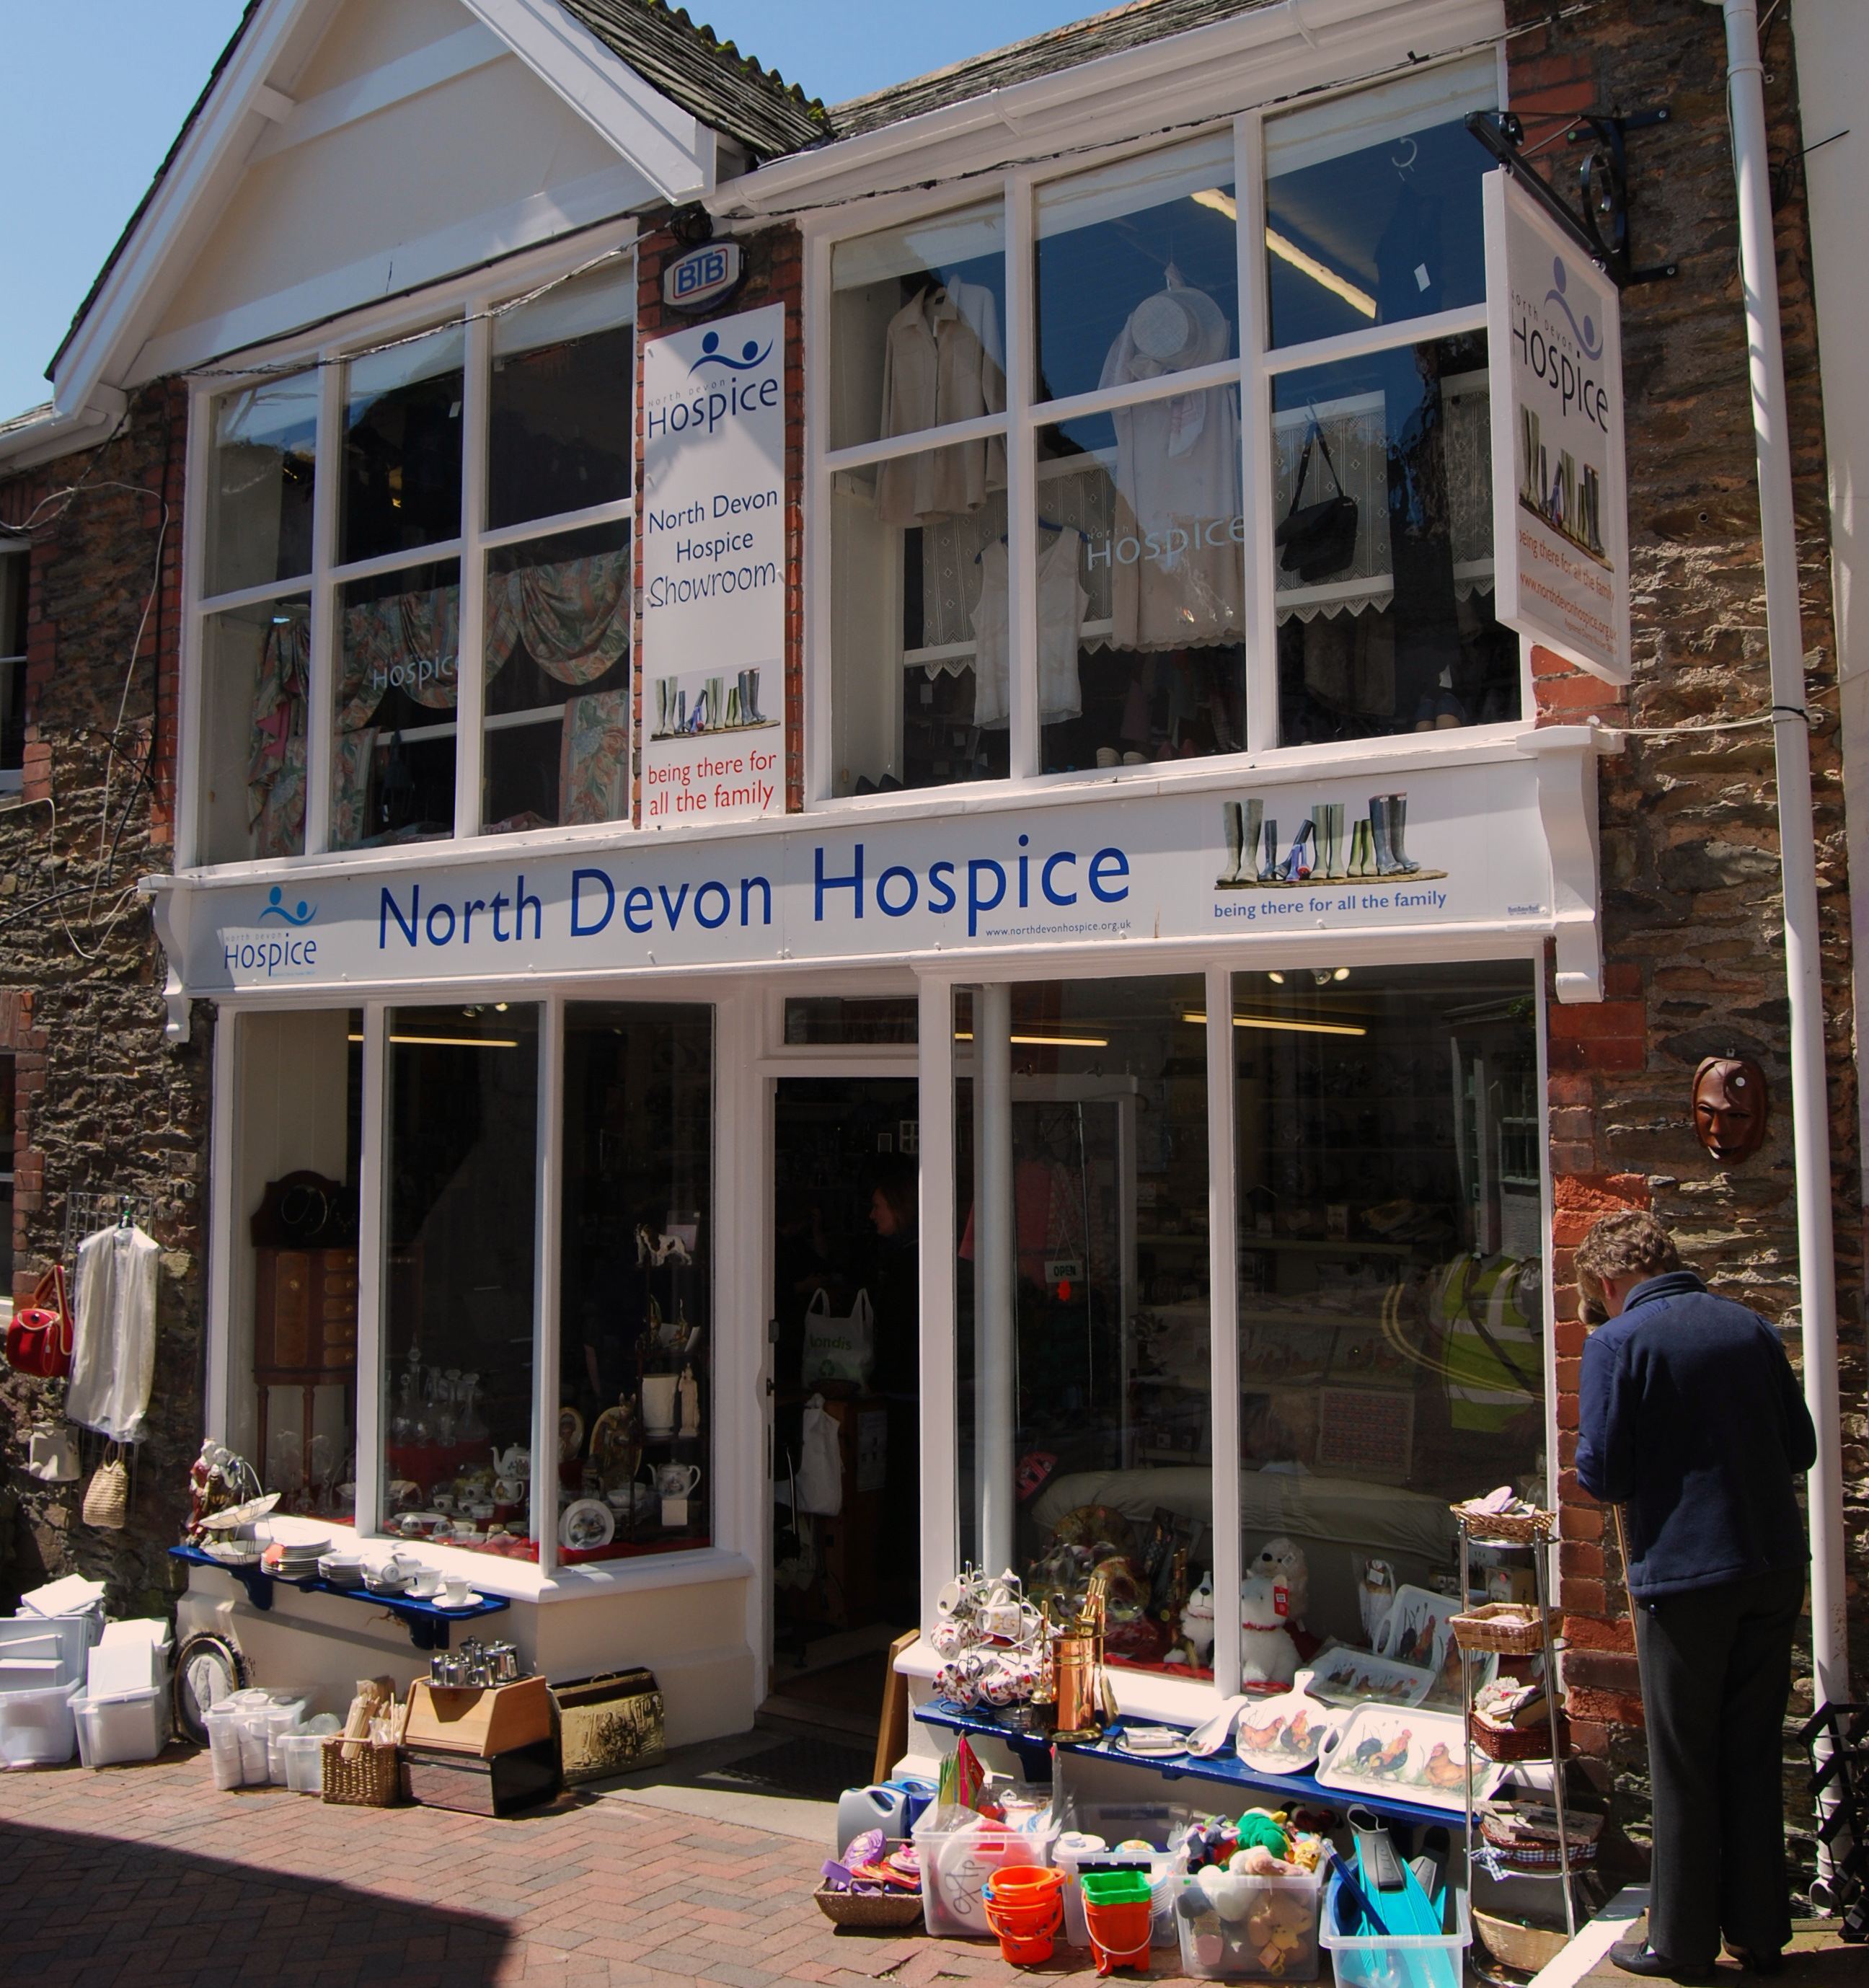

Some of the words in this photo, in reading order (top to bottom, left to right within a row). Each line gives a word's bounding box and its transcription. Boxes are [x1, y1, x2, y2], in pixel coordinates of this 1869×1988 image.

[678, 252, 724, 293] BTB
[1512, 307, 1609, 433] Hospice
[649, 377, 778, 438] Hospice
[649, 500, 704, 534] North
[713, 490, 777, 518] Devon
[677, 531, 754, 563] Hospice
[1087, 513, 1244, 571] Hospice
[650, 562, 776, 608] Showroom
[1539, 539, 1559, 567] there
[1561, 552, 1571, 575] for
[1583, 570, 1594, 591] the
[648, 763, 691, 786] being
[697, 756, 743, 778] there
[749, 750, 777, 771] for
[650, 791, 668, 816] all
[676, 788, 707, 812] the
[715, 779, 774, 810] family
[379, 875, 542, 949] North
[570, 868, 772, 937] Devon
[814, 834, 1130, 937] Hospice
[1214, 903, 1256, 920] being
[1261, 900, 1304, 916] there
[1309, 898, 1333, 912] for
[1338, 895, 1356, 911] all
[1361, 894, 1389, 909] the
[1394, 891, 1447, 909] family
[986, 919, 1131, 936] www.northdevonhospice.org.uk
[224, 932, 317, 976] Hospice
[1053, 1265, 1077, 1276] OPEN
[810, 1334, 852, 1351] londis
